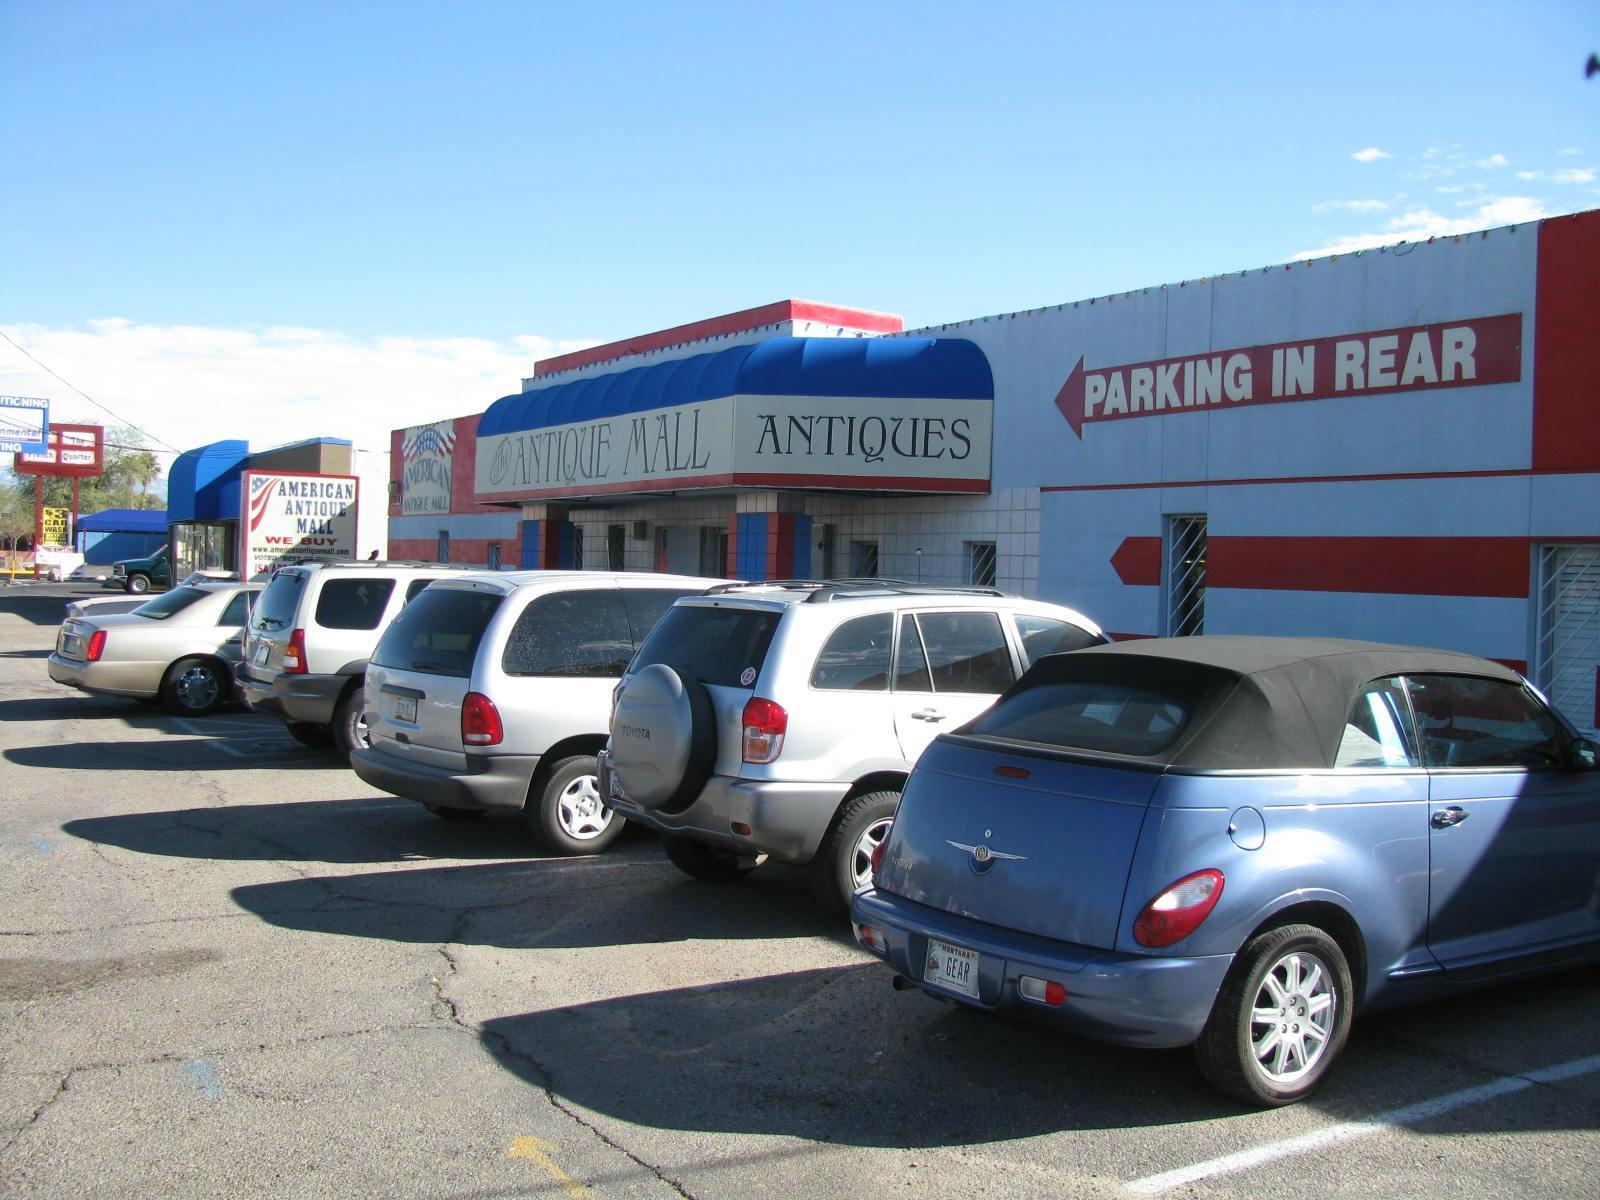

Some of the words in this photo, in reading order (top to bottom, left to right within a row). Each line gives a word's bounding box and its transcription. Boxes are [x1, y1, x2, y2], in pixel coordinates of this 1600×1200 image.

[1084, 352, 1253, 418] PARKING
[1271, 345, 1316, 397] IN
[1335, 325, 1478, 392] REAR
[754, 414, 971, 463] ANTIQUES
[511, 422, 612, 486] ANTIQUE
[623, 409, 711, 476] MALL
[63, 452, 92, 461] Quarter
[279, 481, 353, 499] AMERICAN
[285, 500, 347, 517] ANTIQUE
[297, 518, 334, 534] MALL
[265, 536, 294, 545] WE
[300, 537, 339, 546] BUY
[622, 725, 651, 741] TOYOTA
[946, 957, 969, 983] GEAR
